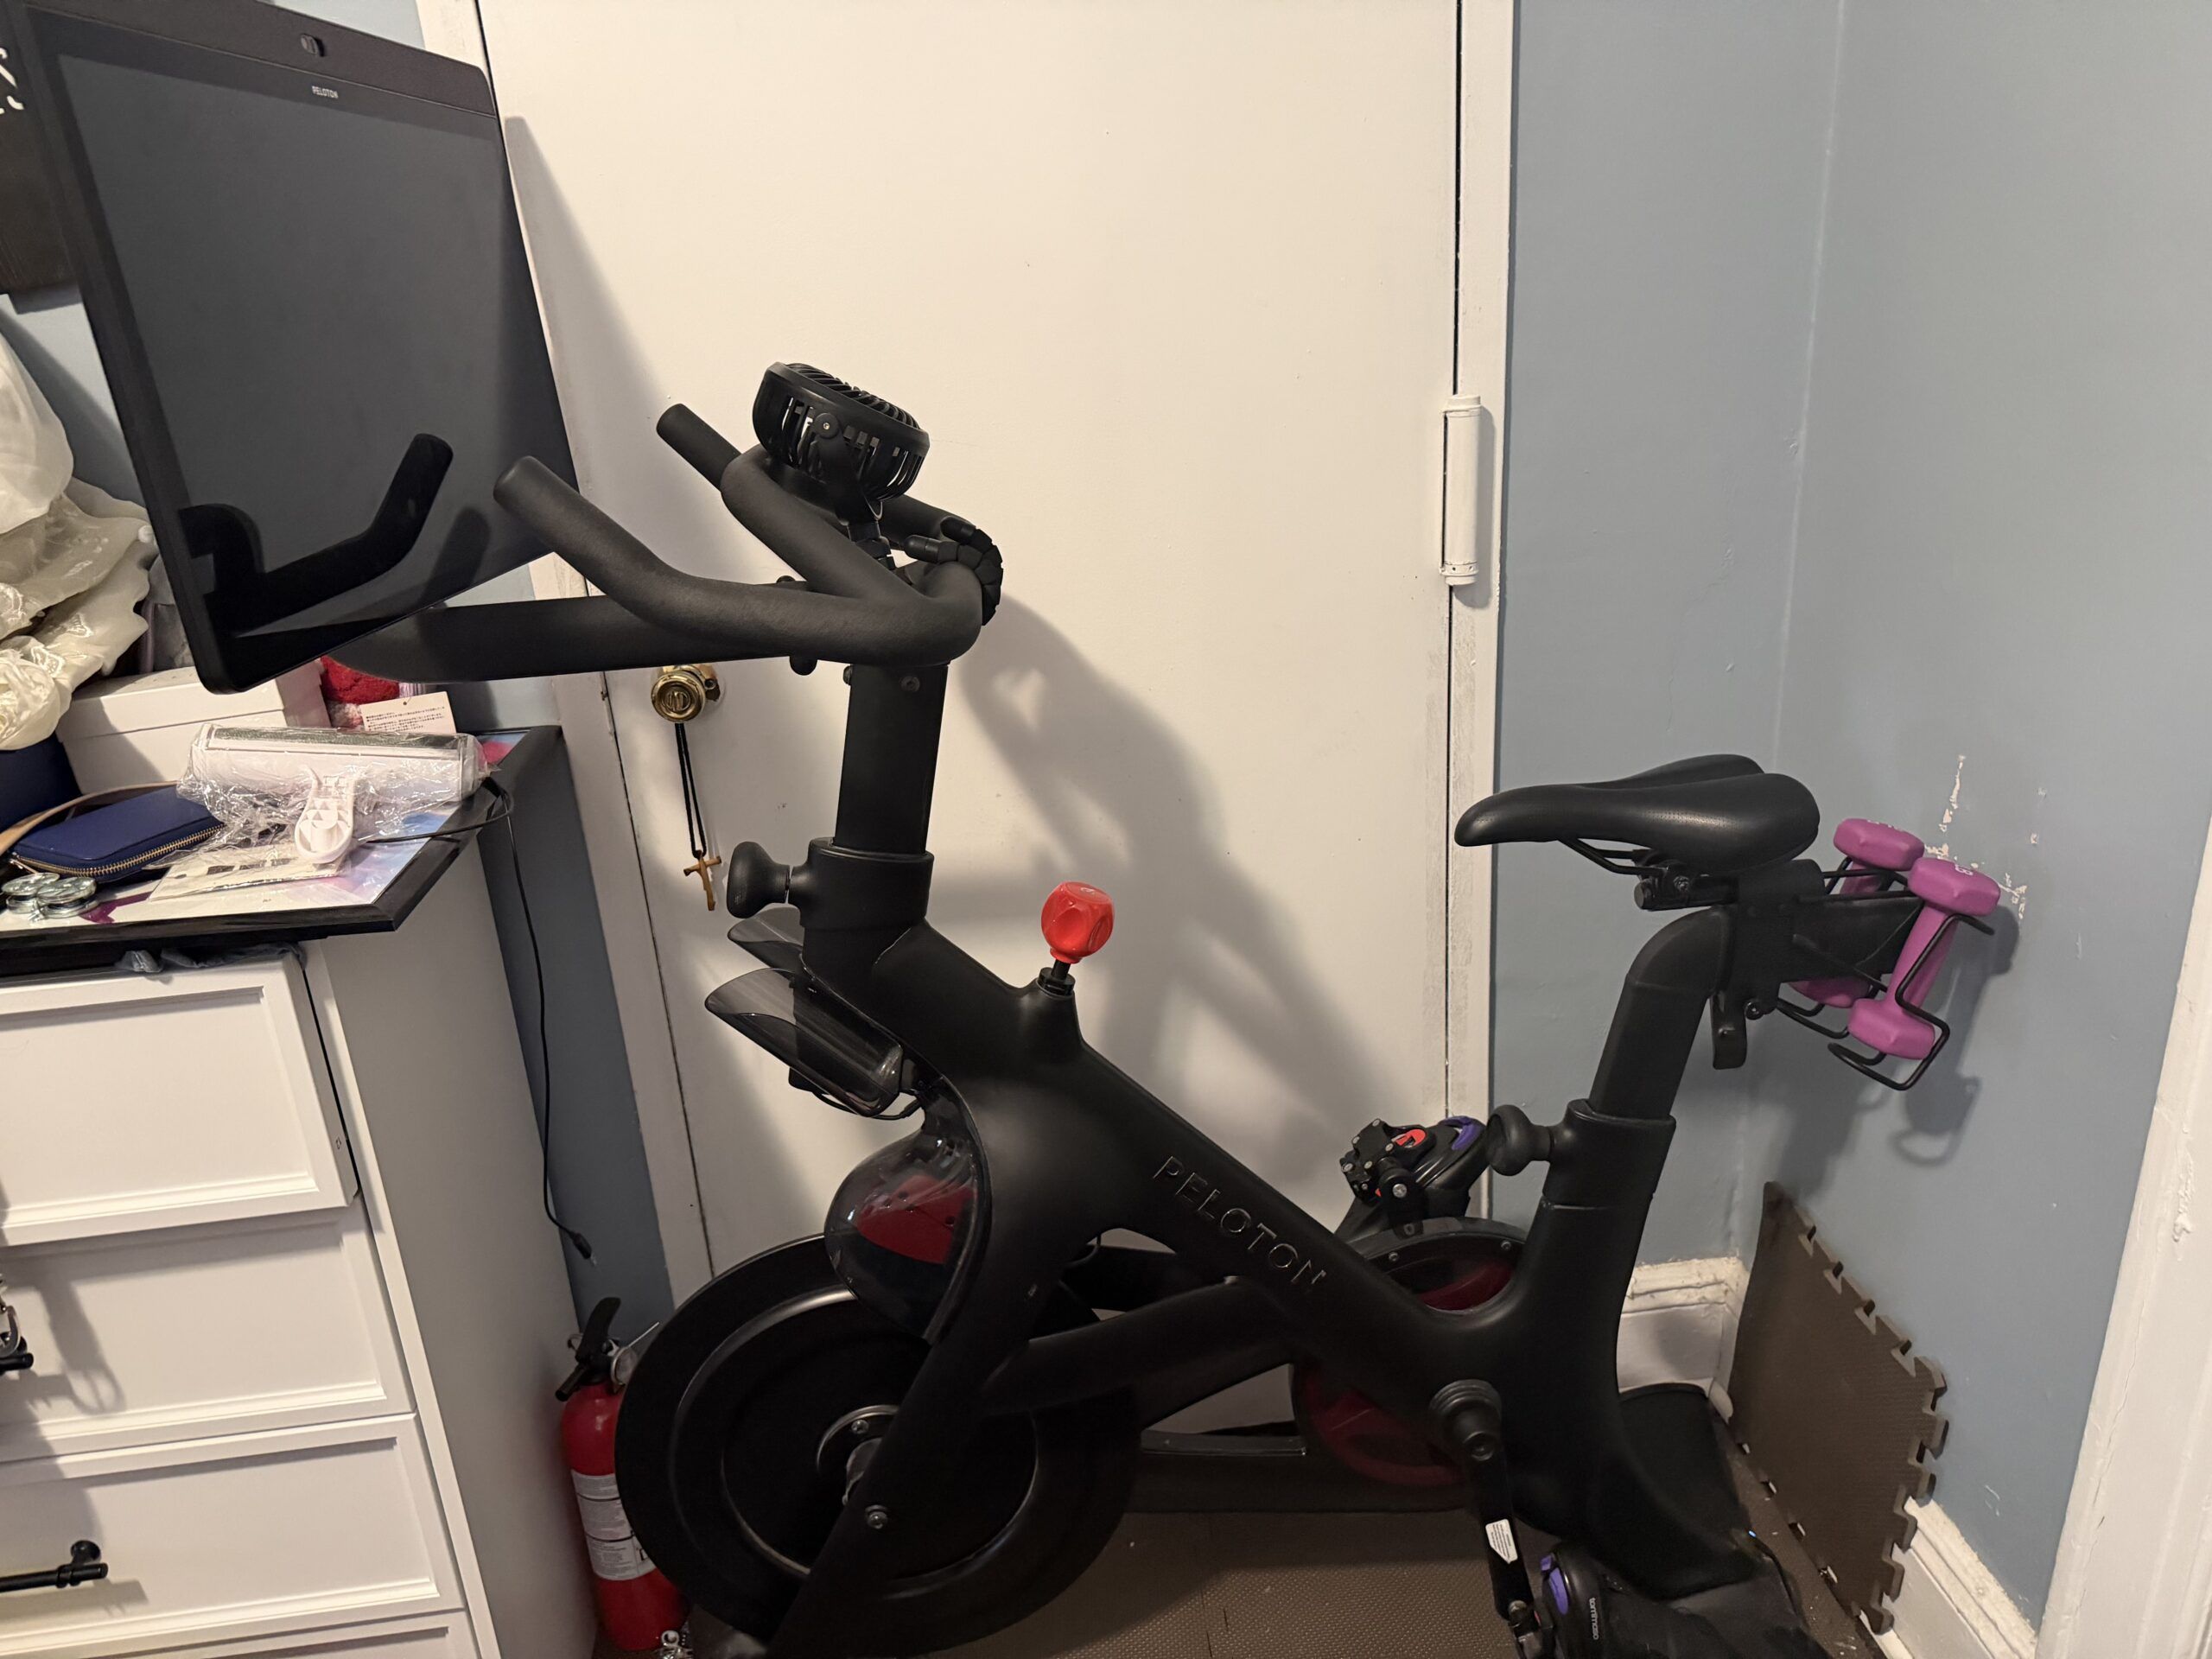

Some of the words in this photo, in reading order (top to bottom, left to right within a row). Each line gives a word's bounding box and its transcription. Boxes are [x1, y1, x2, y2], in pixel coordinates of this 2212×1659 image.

[312, 86, 339, 99] PELOTON
[1153, 1155, 1326, 1291] PELOTON
[1589, 1598, 1599, 1640] tommaso
